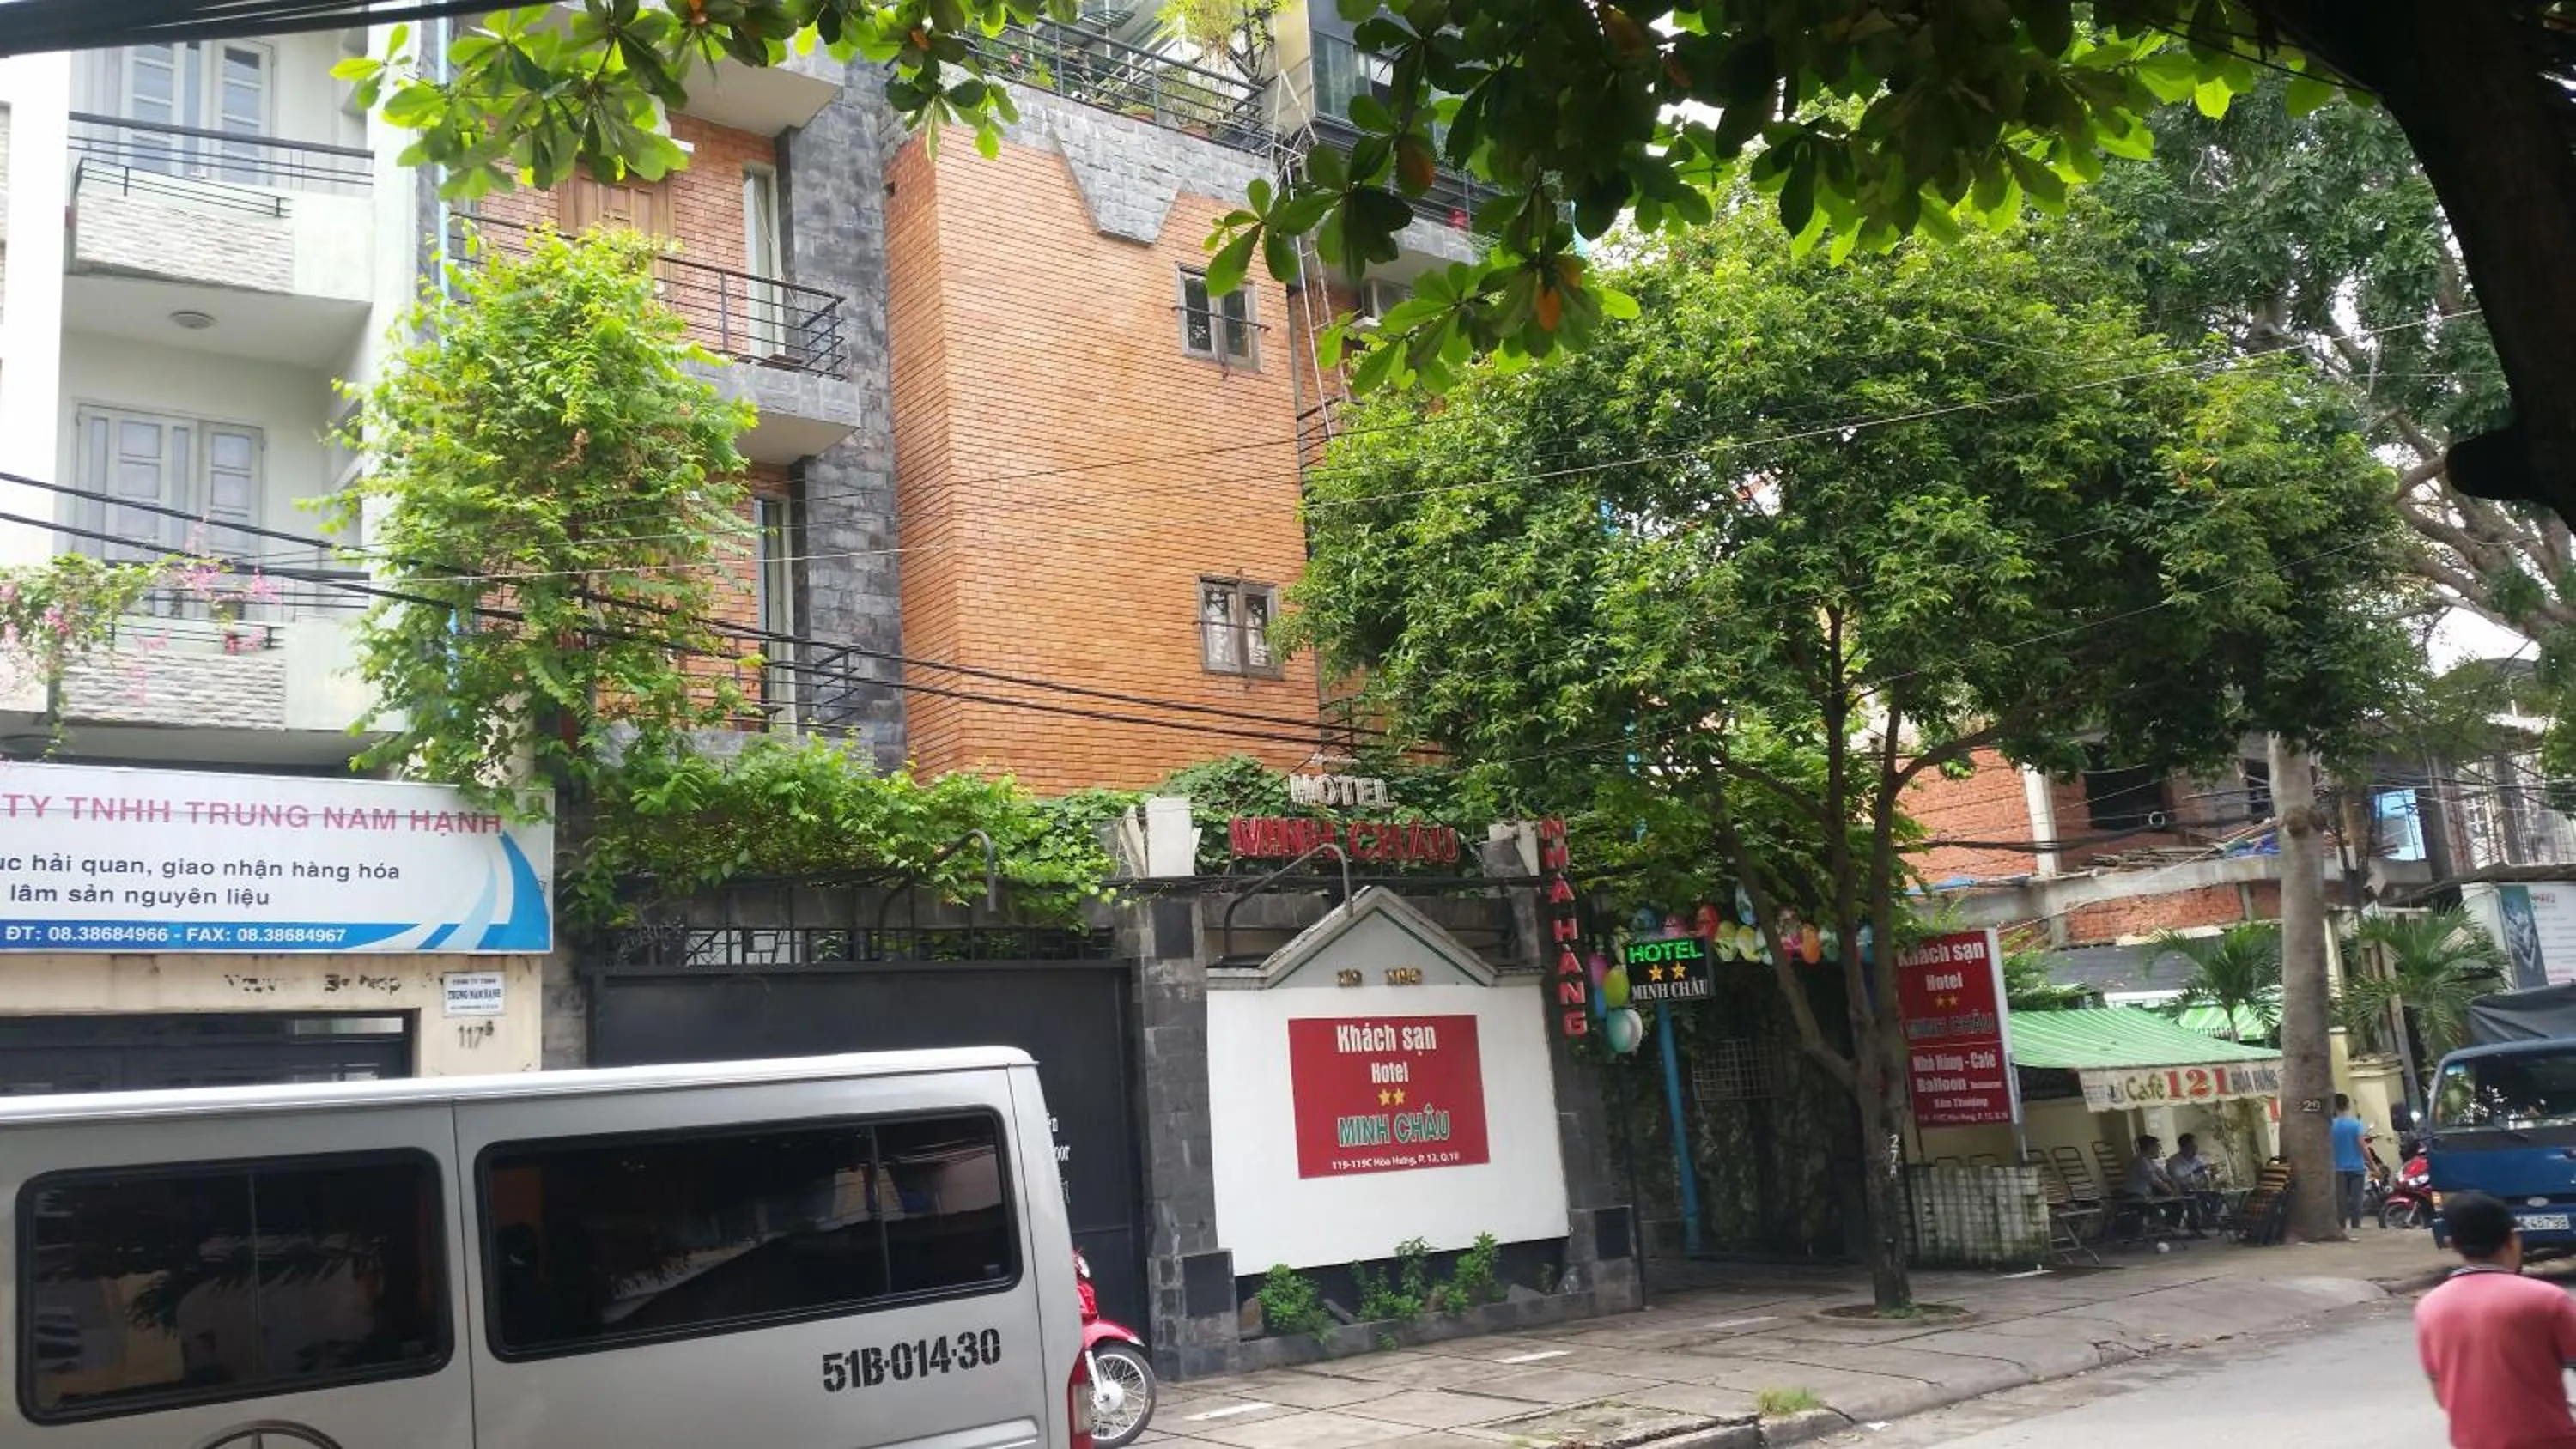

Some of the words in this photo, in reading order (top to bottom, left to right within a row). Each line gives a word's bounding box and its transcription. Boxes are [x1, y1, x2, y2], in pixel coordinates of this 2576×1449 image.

[2, 794, 52, 818] TY
[65, 797, 171, 822] TNHH
[185, 802, 310, 828] TRUNG
[324, 807, 397, 830] NAM
[410, 810, 502, 836] HẠNH
[32, 853, 72, 872] hải
[82, 859, 153, 877] quan,
[162, 858, 216, 878] giao
[223, 859, 283, 880] nhận
[293, 861, 349, 882] hàng
[358, 862, 400, 880] hóa
[10, 884, 58, 903] lâm
[68, 885, 114, 903] sản
[125, 888, 217, 909] nguyên
[228, 888, 270, 908] liệu
[5, 926, 42, 941] ĐT:
[47, 927, 169, 943] 08.38684966
[186, 928, 231, 943] FAX:
[236, 929, 347, 943] 08.38684967
[1628, 940, 1704, 964] HOTEL
[1952, 942, 1985, 965] sạn
[1631, 983, 1668, 1000] MINH
[1670, 977, 1708, 997] CHÂU
[1925, 971, 1964, 992] Hotel
[1336, 1022, 1397, 1053] Khách
[1402, 1025, 1437, 1057] sạn
[1371, 1061, 1409, 1084] Hotel
[2165, 1067, 2232, 1100] 121
[1338, 1114, 1390, 1148] MINH
[1394, 1102, 1450, 1144] CHÂU
